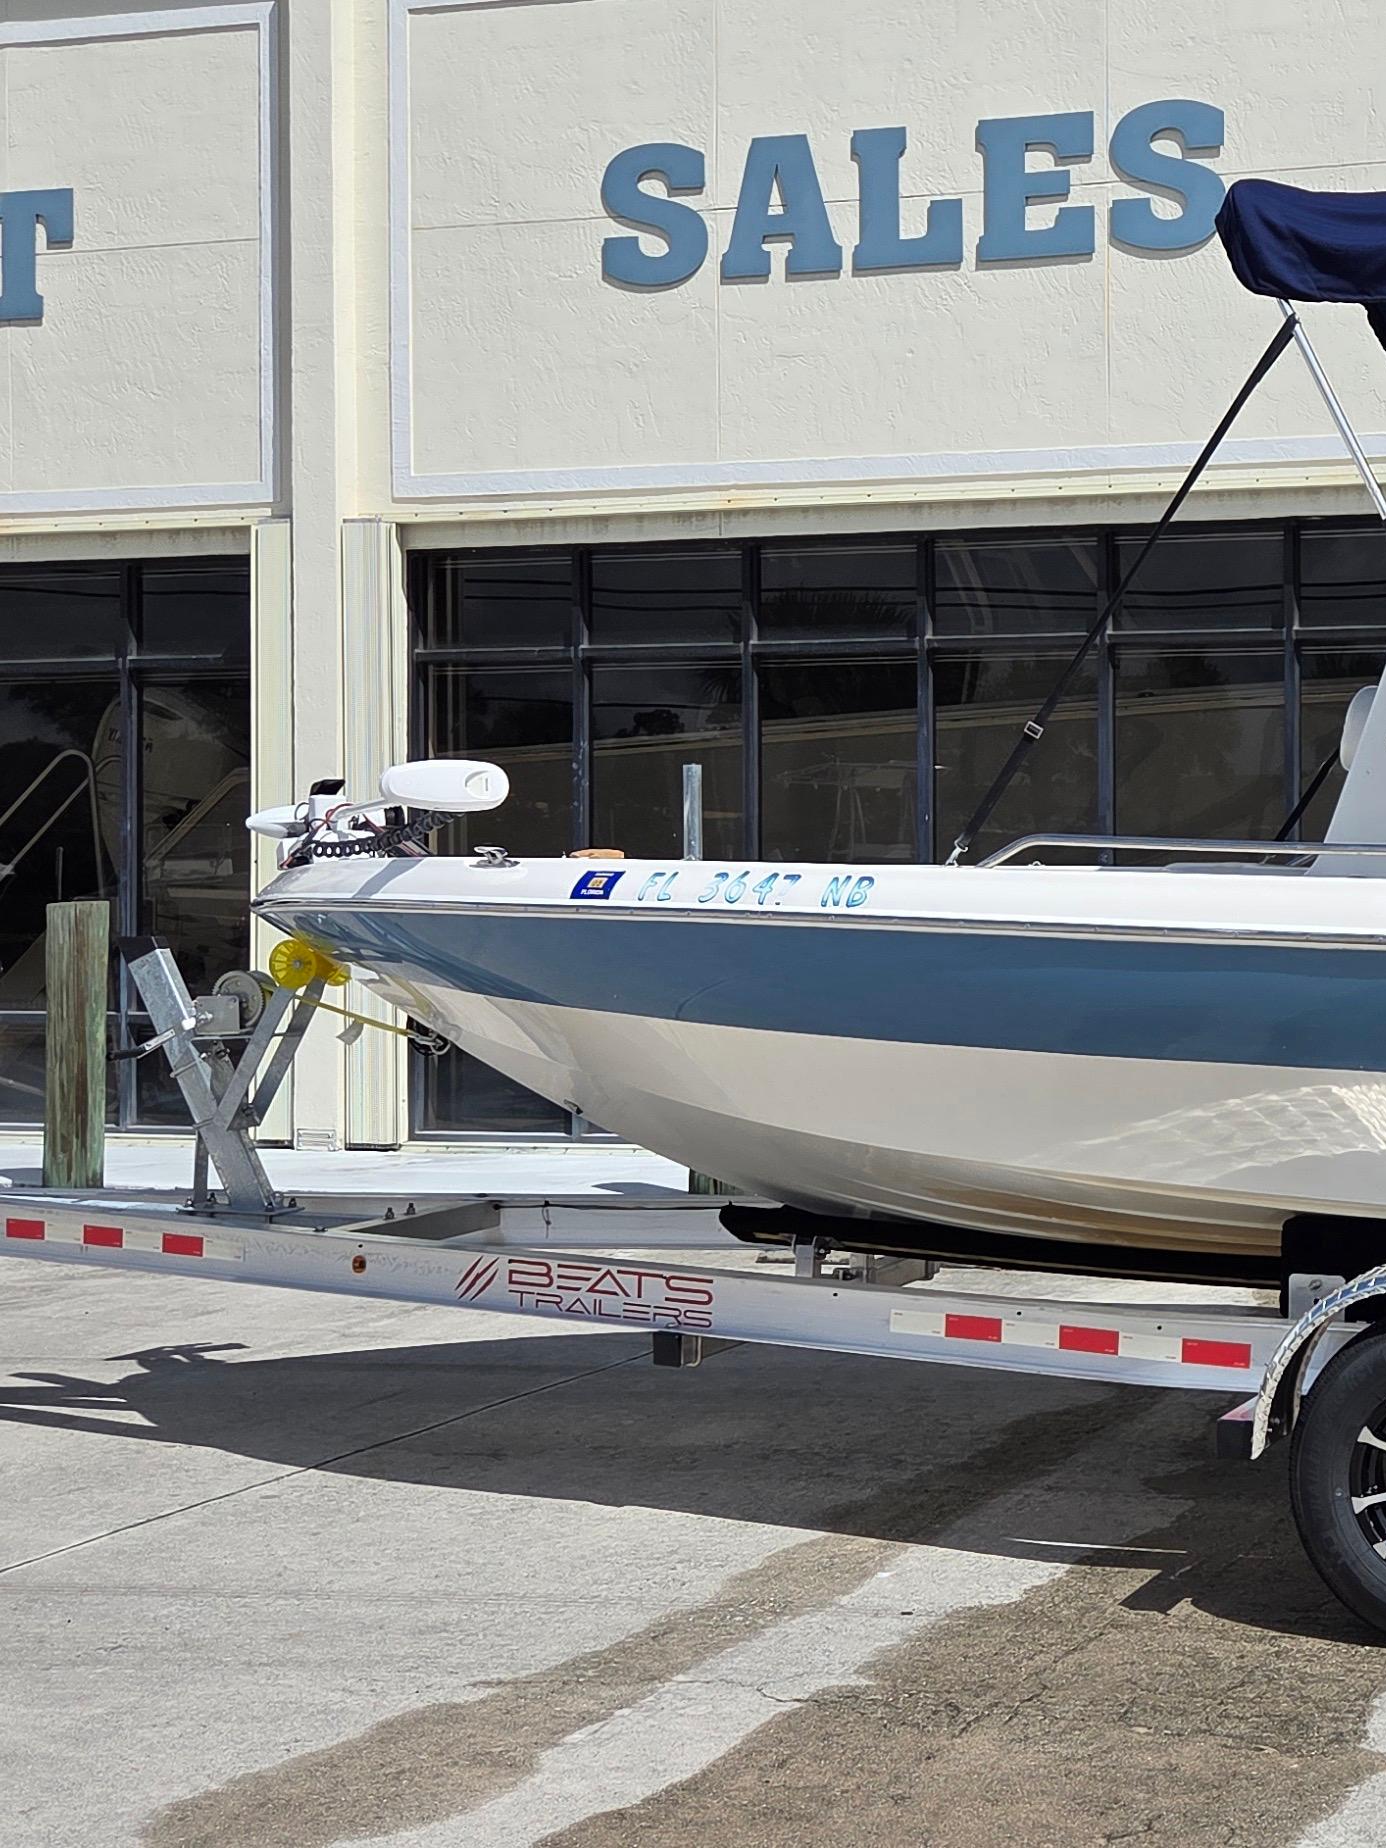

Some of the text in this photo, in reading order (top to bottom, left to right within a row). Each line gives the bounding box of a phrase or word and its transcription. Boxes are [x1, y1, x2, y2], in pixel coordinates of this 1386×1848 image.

[601, 99, 1226, 287] SALES
[637, 870, 875, 908] FL 3647 NB
[508, 1258, 714, 1306] BEATS
[508, 1289, 712, 1330] TRAILERS
